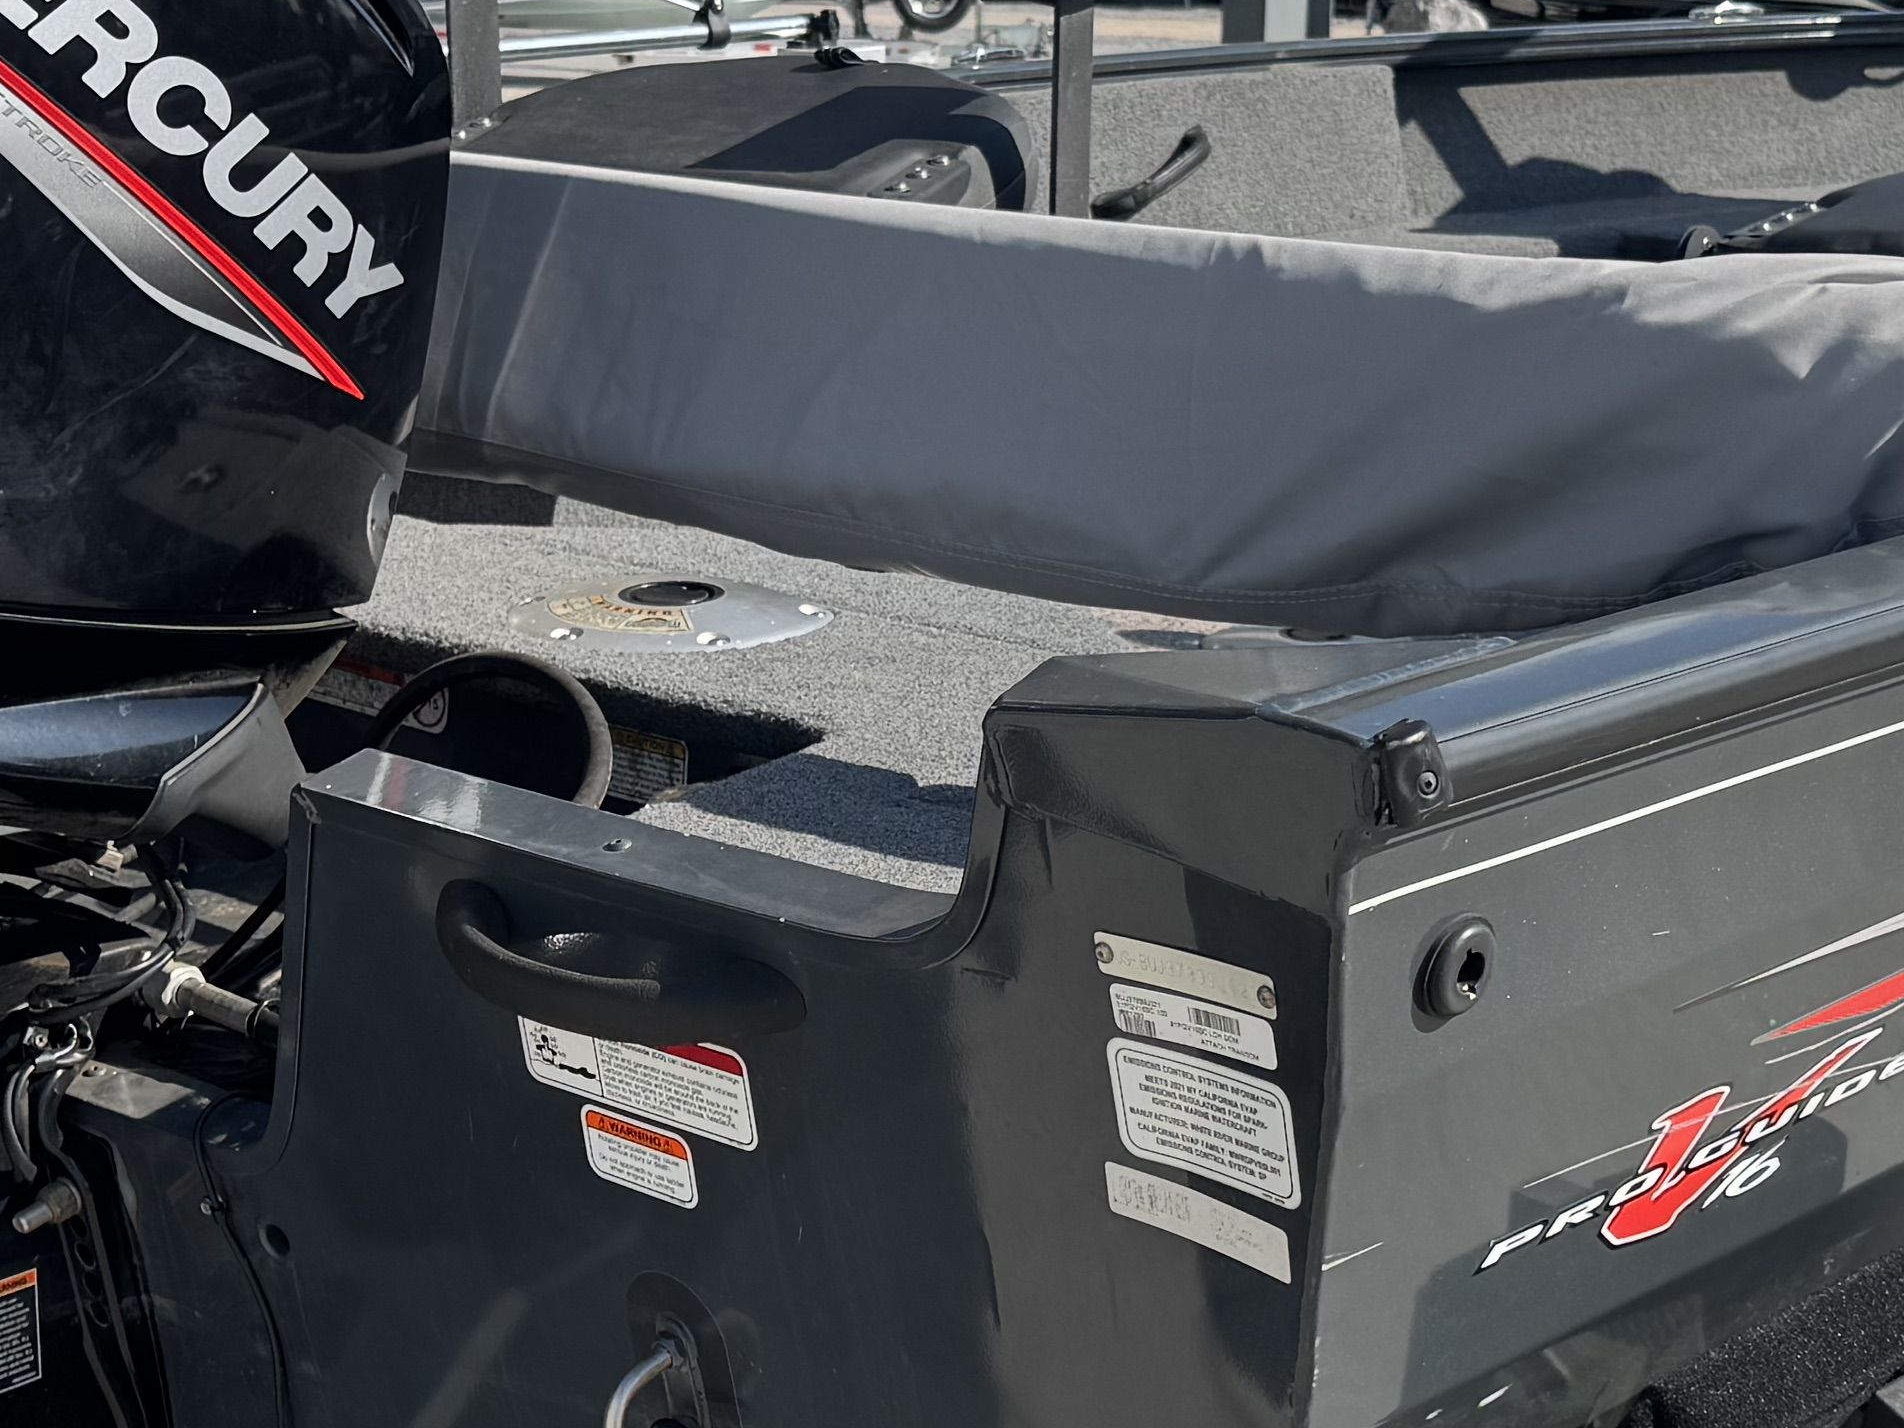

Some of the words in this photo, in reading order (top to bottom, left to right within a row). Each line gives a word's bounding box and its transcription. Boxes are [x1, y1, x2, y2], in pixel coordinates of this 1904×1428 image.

[608, 1120, 661, 1146] WARNING
[1701, 1135, 1788, 1211] 16
[1476, 1162, 1667, 1273] PRO
